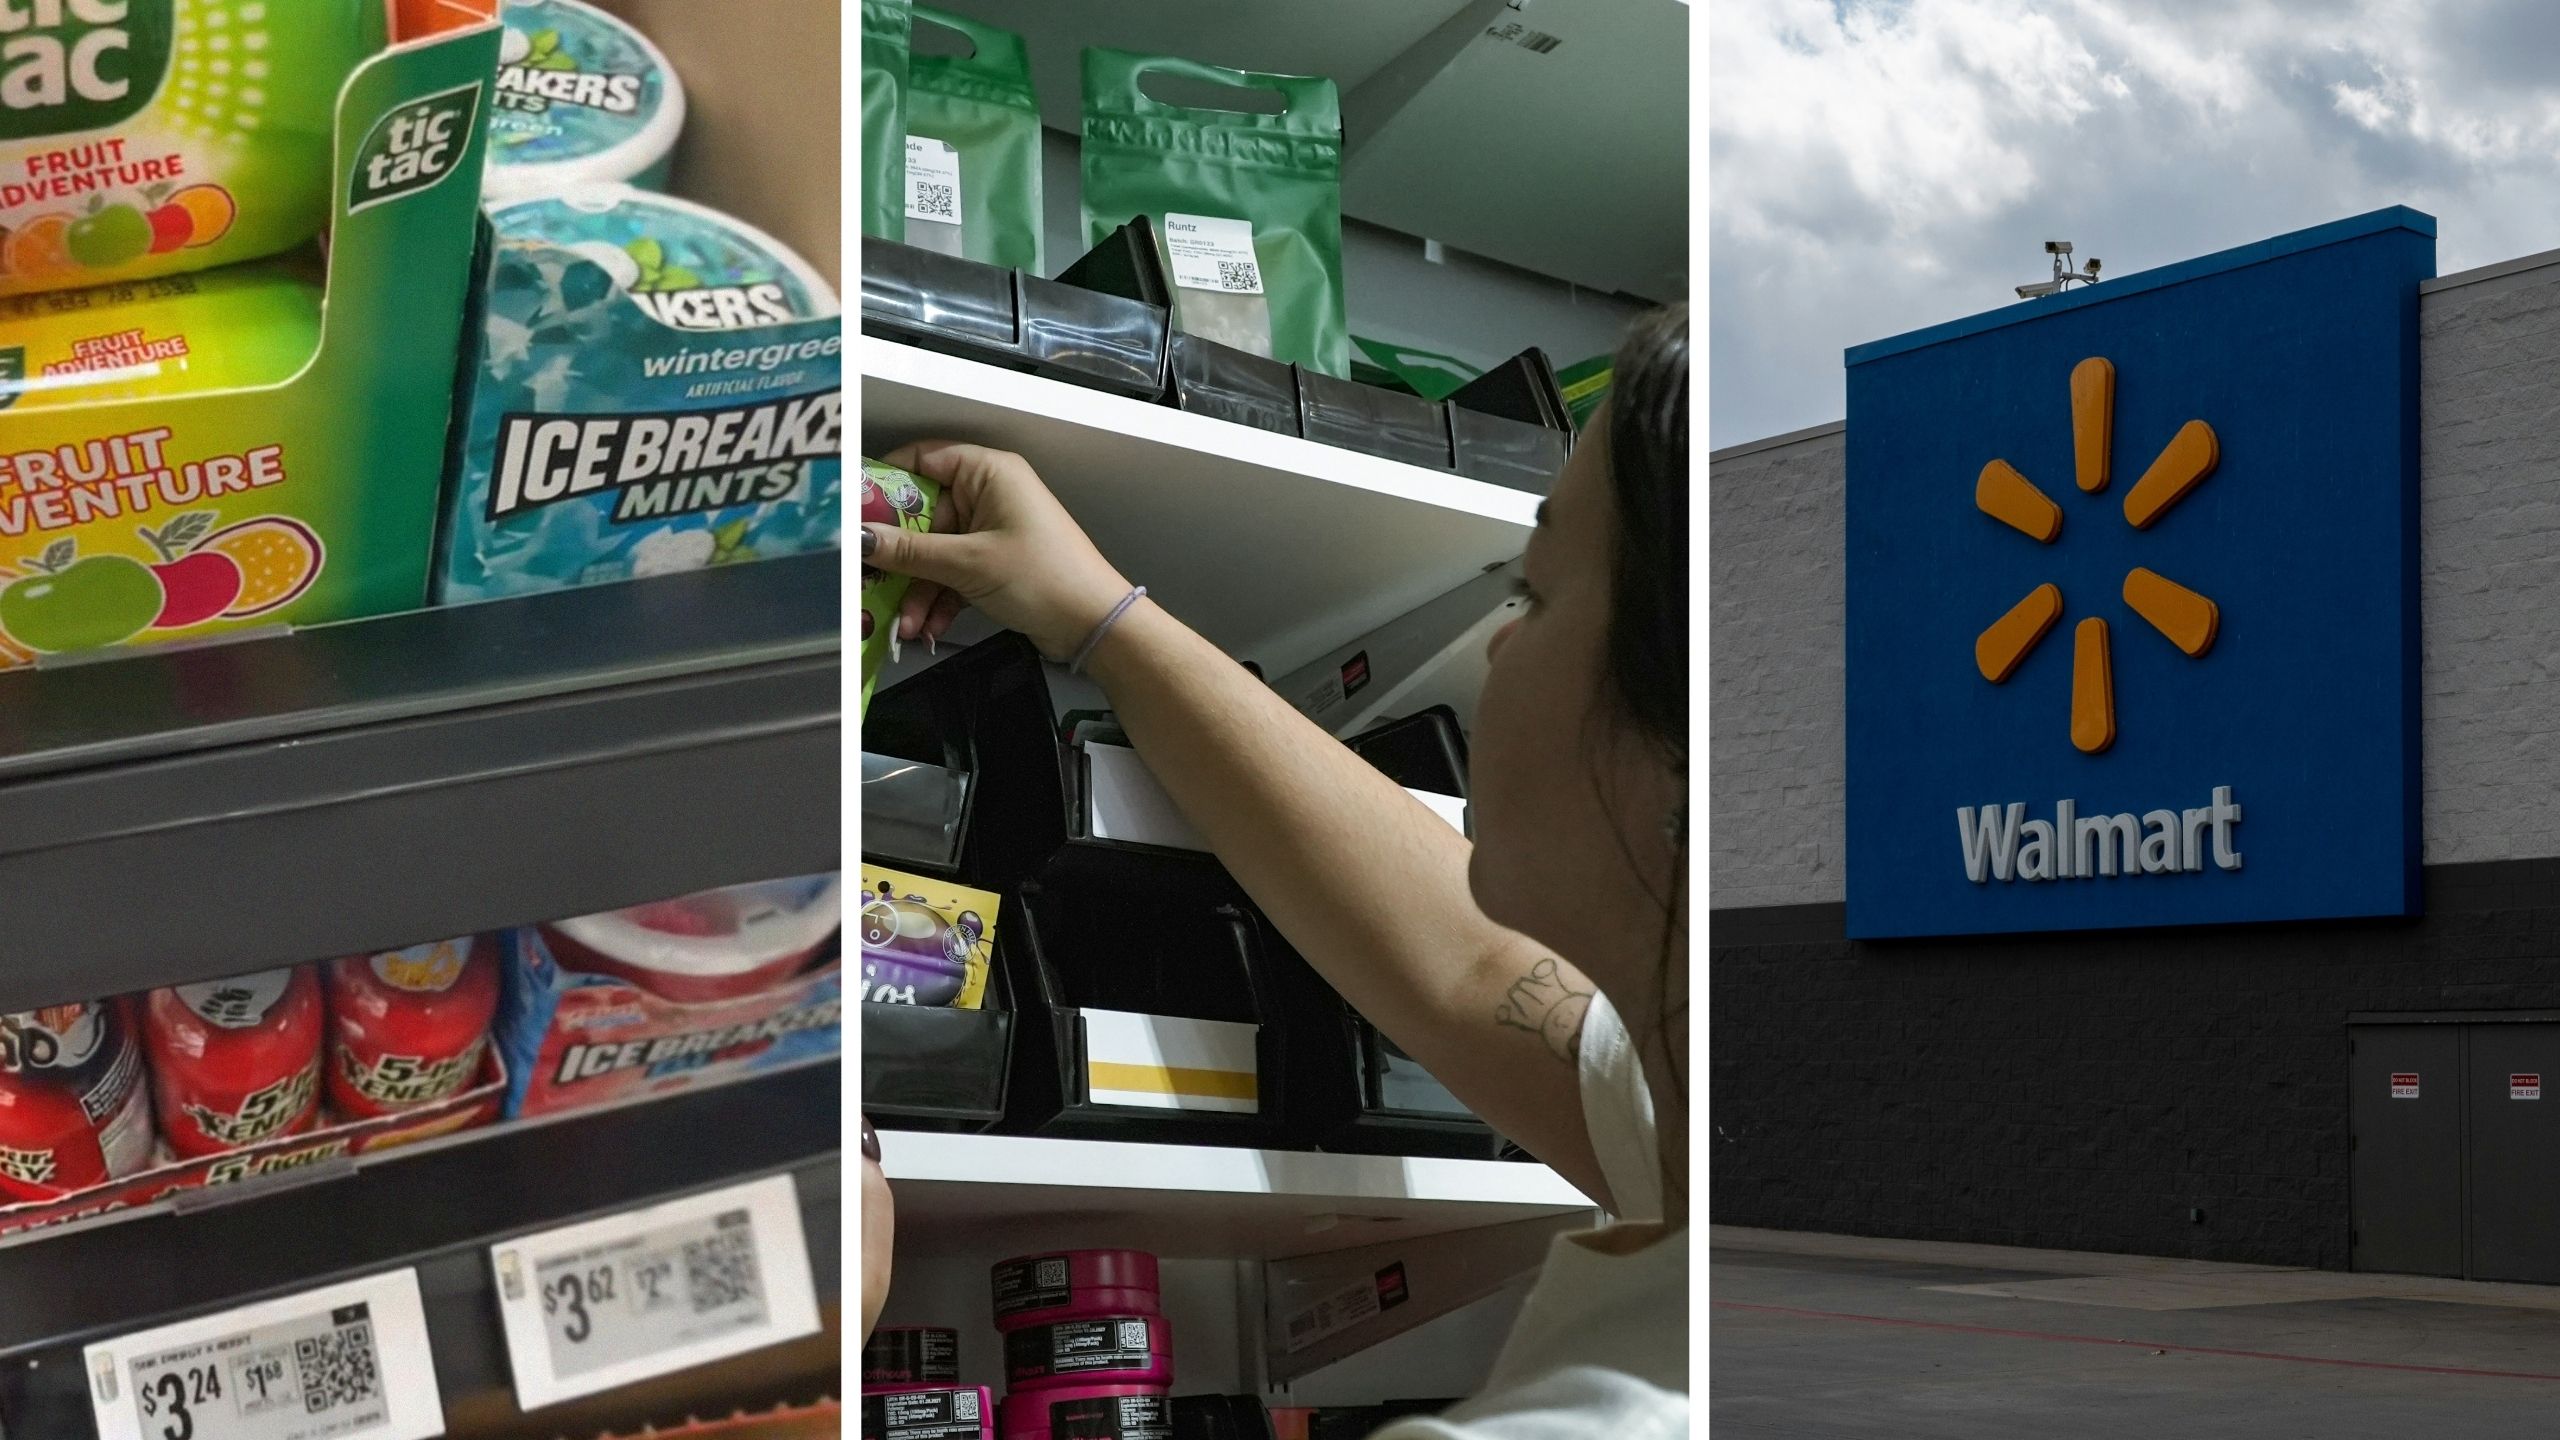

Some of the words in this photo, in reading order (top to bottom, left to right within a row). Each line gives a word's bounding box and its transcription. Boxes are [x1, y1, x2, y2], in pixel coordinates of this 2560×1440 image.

[496, 67, 640, 113] AKERS
[388, 108, 452, 155] tic
[26, 138, 125, 177] FRUIT
[367, 139, 450, 190] tac
[0, 154, 184, 209] DVENTURE
[1168, 221, 1197, 232] Runtz
[43, 337, 187, 377] ADVENTURE
[71, 330, 143, 358] FRUIT
[644, 335, 841, 377] wintergree
[685, 379, 751, 398] ARTIFICIAL
[495, 418, 619, 514] ICE
[617, 460, 798, 520] MINTS
[1957, 786, 2242, 884] Walmart
[557, 1040, 646, 1084] ICE
